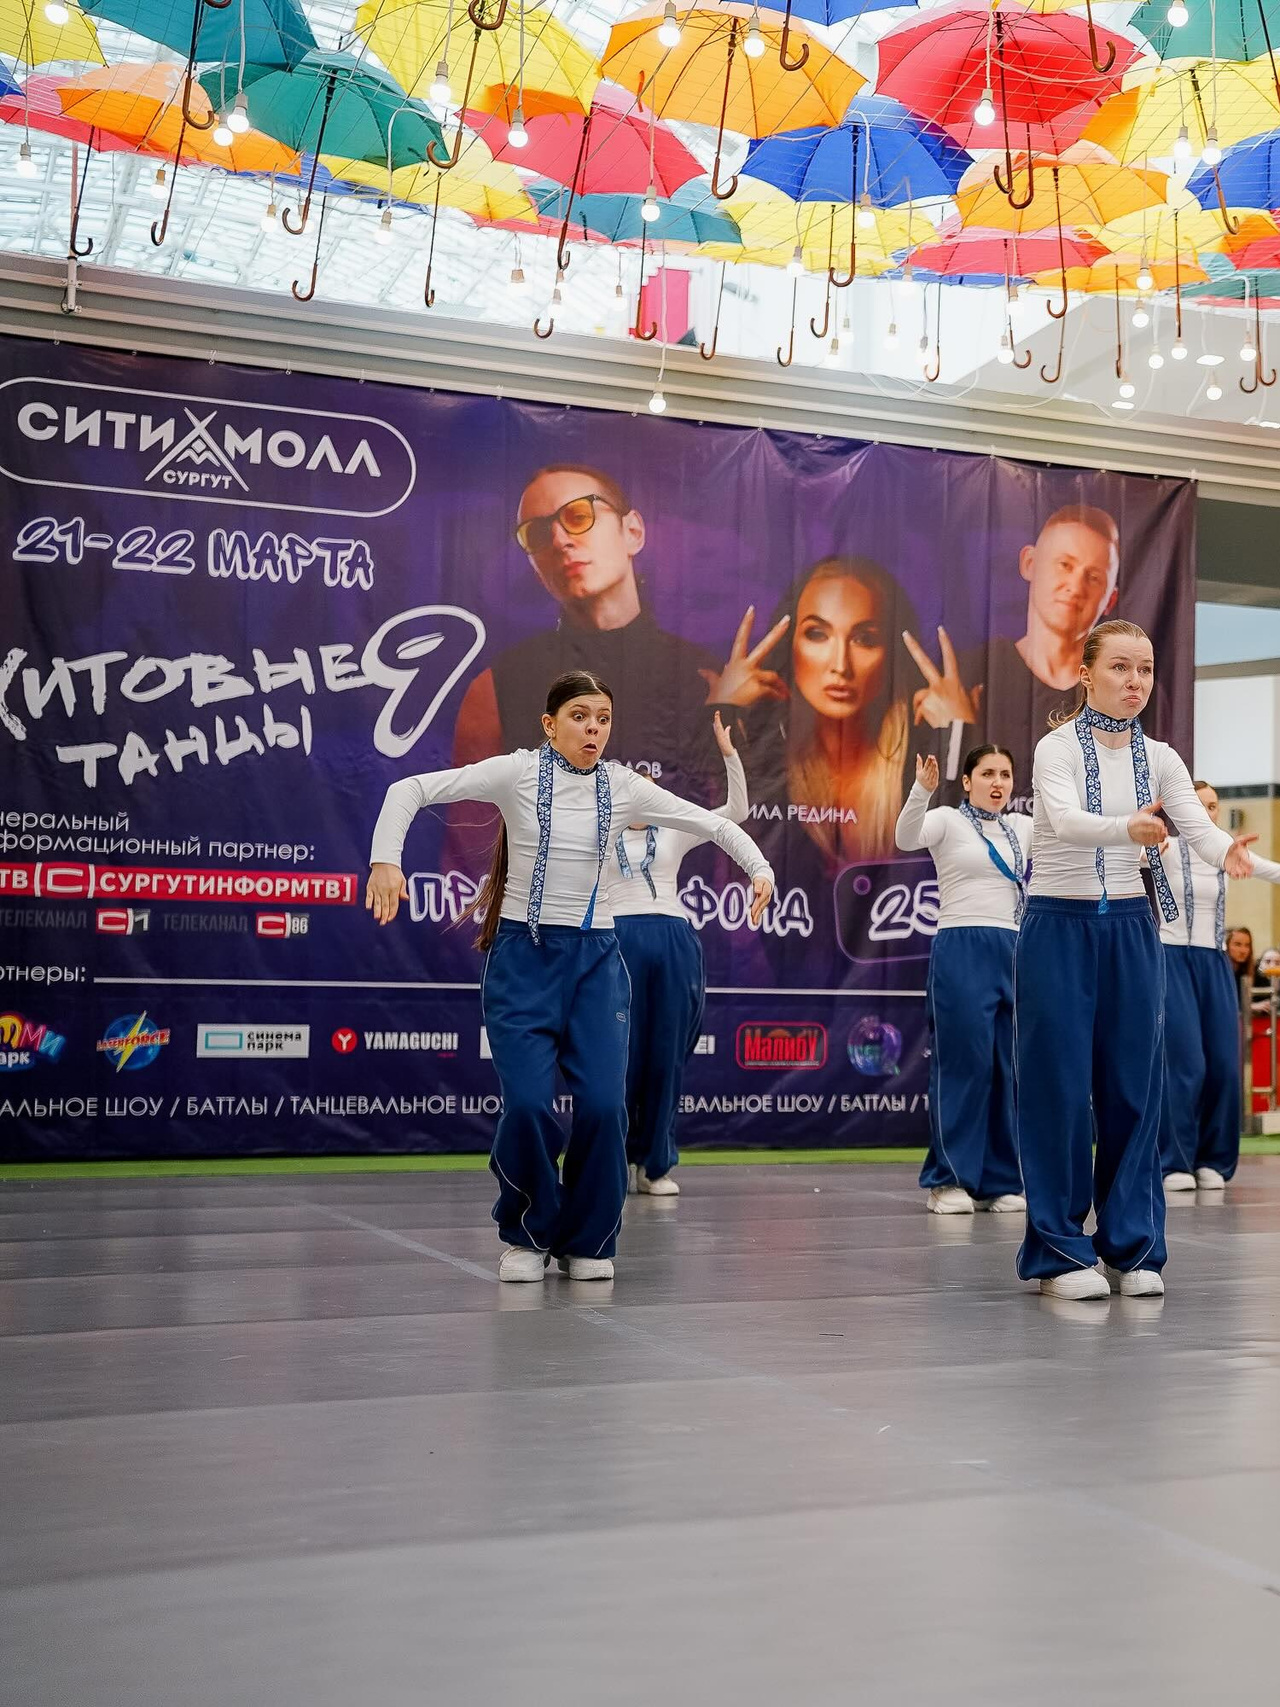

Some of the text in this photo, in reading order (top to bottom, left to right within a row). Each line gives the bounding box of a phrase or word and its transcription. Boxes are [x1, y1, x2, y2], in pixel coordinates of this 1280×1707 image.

[17, 402, 381, 477] СИТИ МОЛЛ
[163, 470, 232, 490] СУРГУТ
[12, 516, 374, 590] 21-22 МАРТА
[56, 703, 312, 788] ТАНЦЫ
[0, 811, 129, 832] еральный
[787, 804, 858, 824] РЕДИНА
[209, 841, 315, 864] партнер:
[164, 912, 248, 932] ТЕЛЕКАНАЛ
[247, 1031, 302, 1042] синема
[364, 1032, 458, 1050] YAMAGUCHI
[247, 1042, 284, 1053] парк
[105, 1096, 163, 1116] ШОУ
[187, 1096, 268, 1116] БАТТЛЫ
[290, 1095, 457, 1116] ТАНЦЕВАЛЬНОЕ
[462, 1095, 504, 1114] ШО
[777, 1094, 824, 1113] ШОУ
[841, 1094, 906, 1113] БАТТЛЫ
